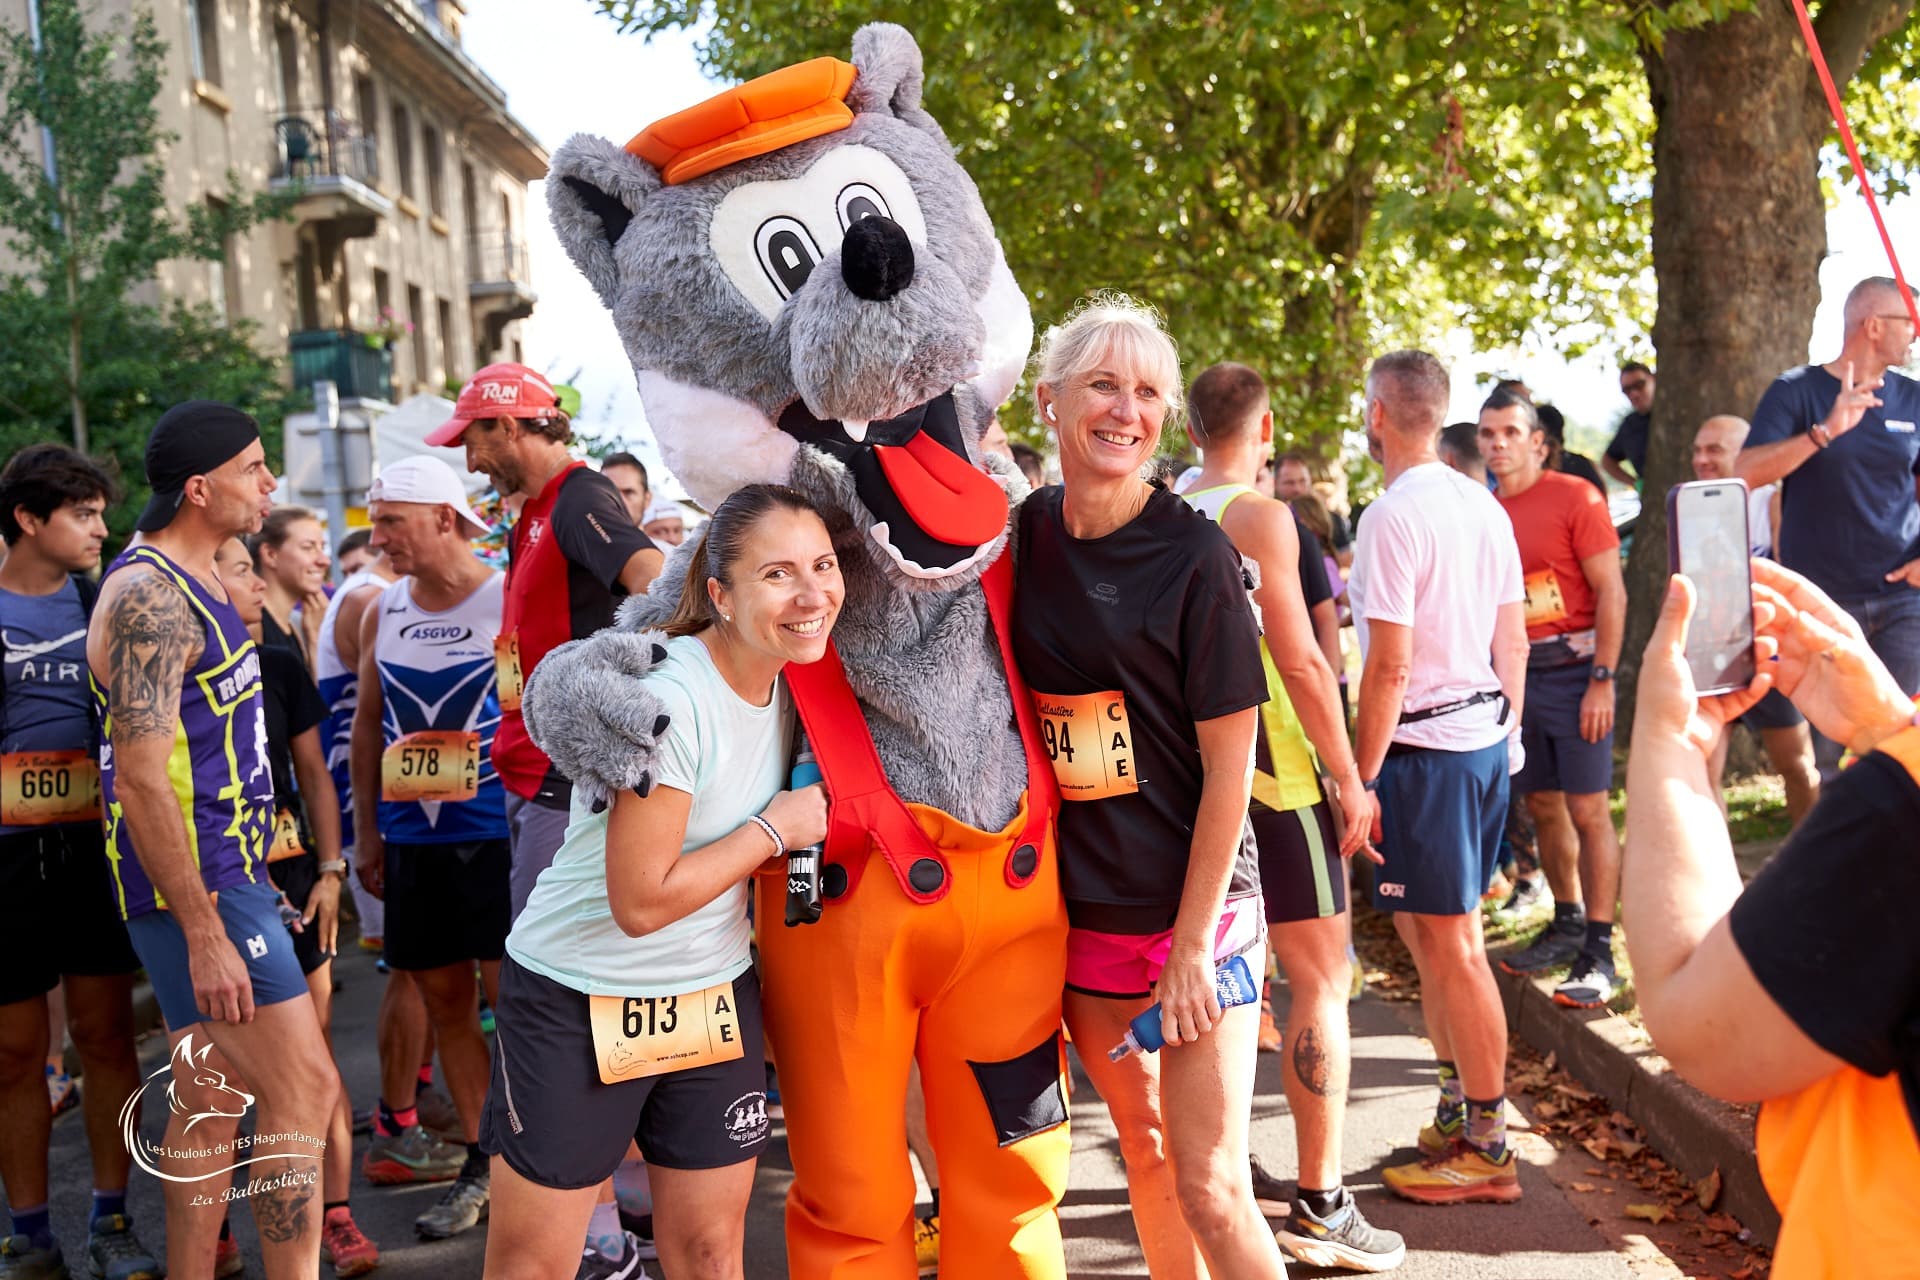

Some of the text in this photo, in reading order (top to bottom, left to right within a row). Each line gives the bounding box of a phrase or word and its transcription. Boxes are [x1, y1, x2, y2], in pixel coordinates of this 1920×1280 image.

[481, 381, 519, 400] RUN
[410, 626, 461, 640] ASGVO
[20, 661, 80, 682] AIR
[401, 747, 439, 776] 578
[21, 768, 70, 799] 660
[622, 996, 678, 1039] 613
